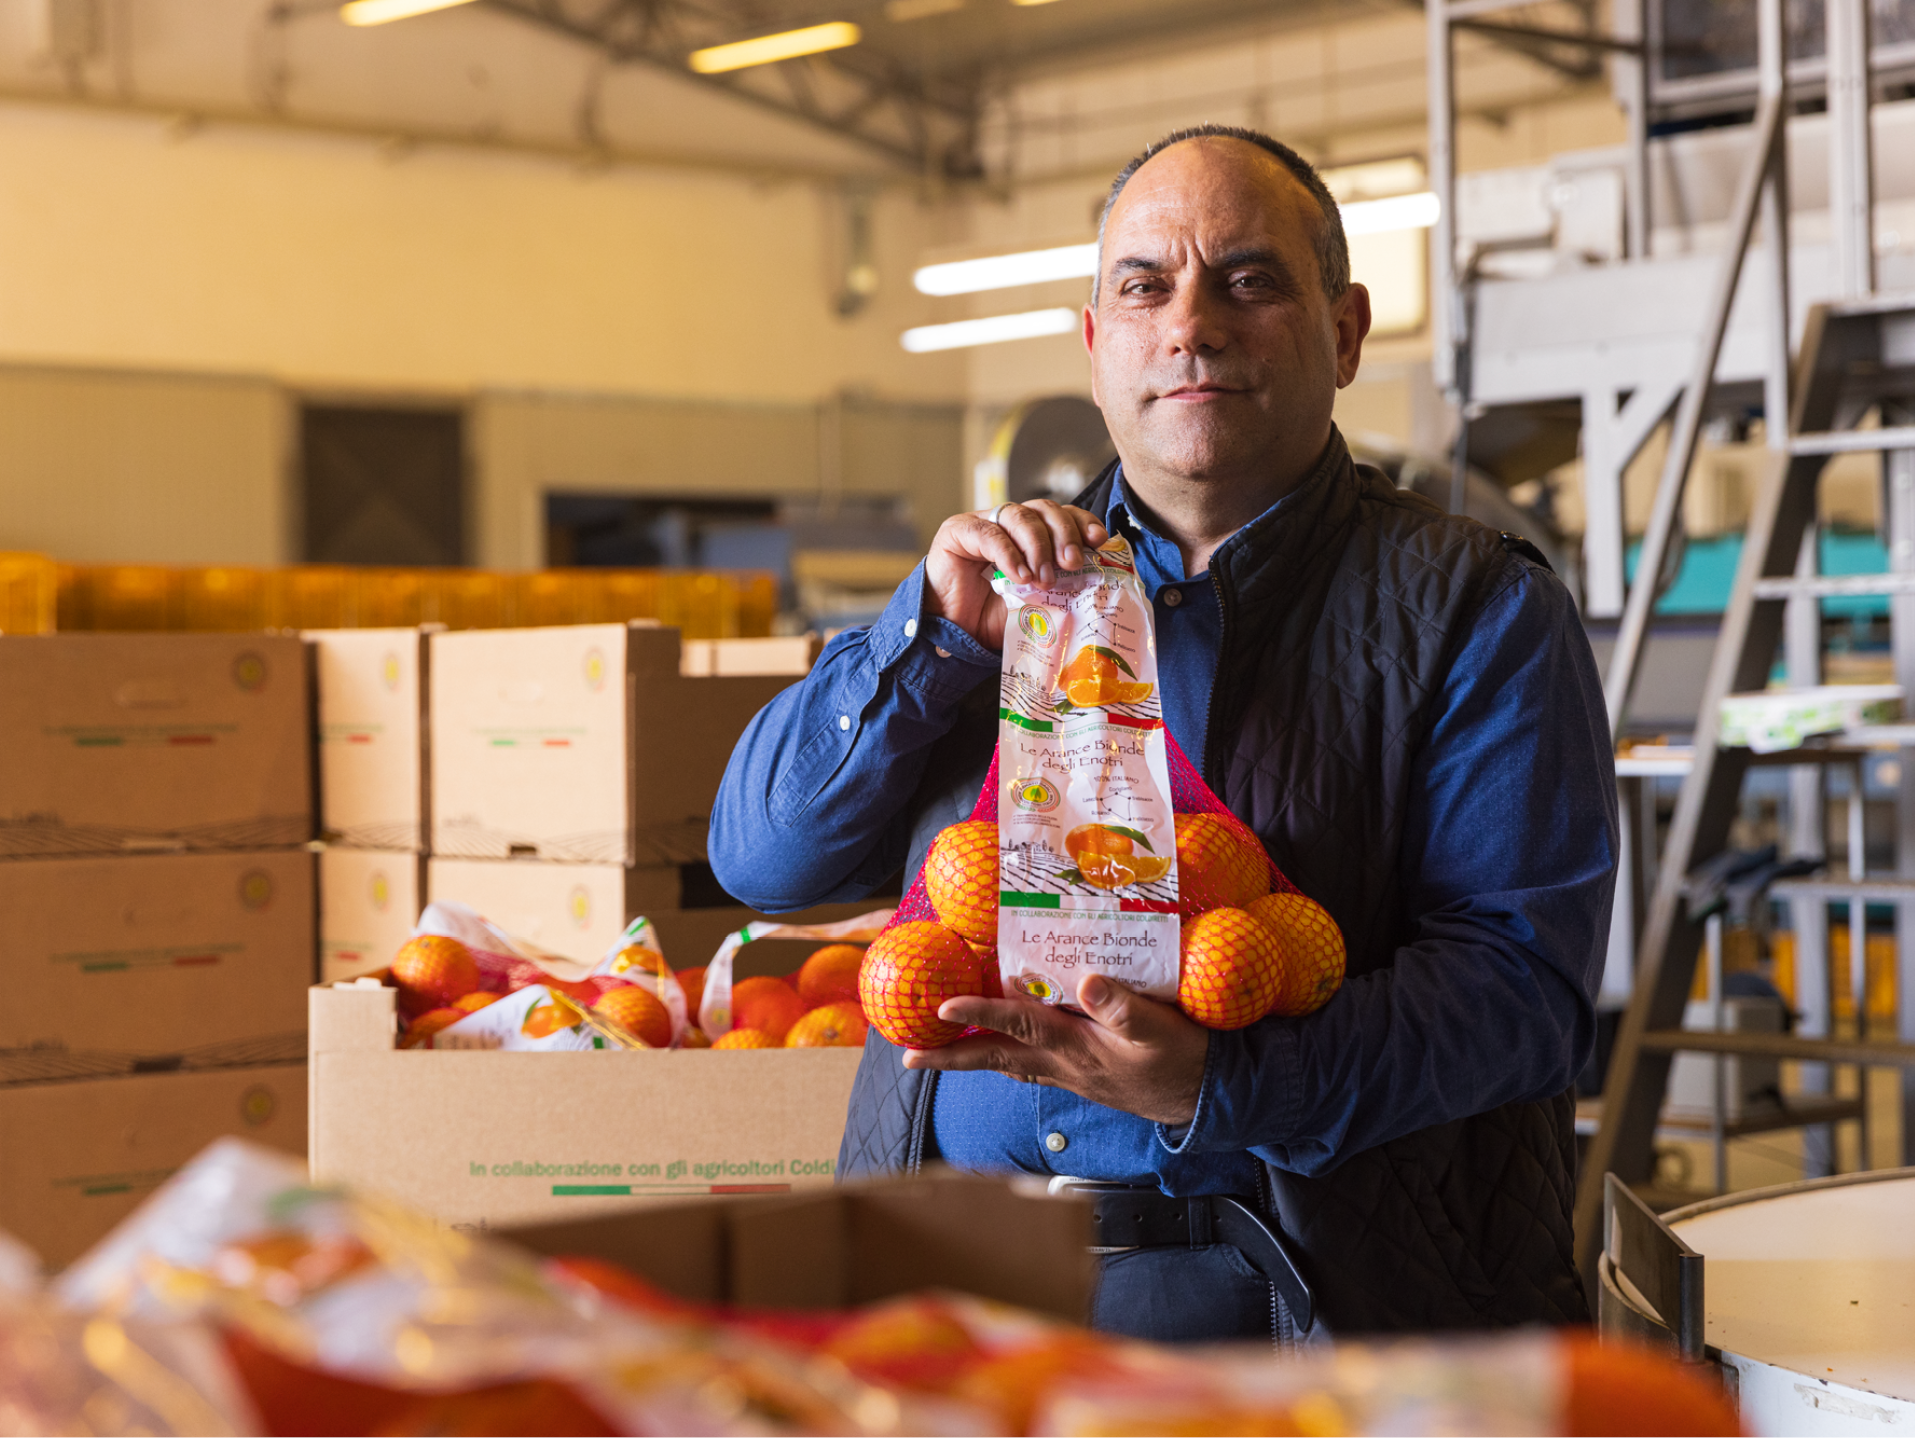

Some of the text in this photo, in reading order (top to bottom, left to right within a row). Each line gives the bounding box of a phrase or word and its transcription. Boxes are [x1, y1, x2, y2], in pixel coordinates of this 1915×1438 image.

[1065, 732, 1078, 740] CON
[1087, 723, 1122, 734] AGRICOLTORI
[1020, 739, 1145, 758] Le Arance Bionde
[1041, 756, 1123, 774] degli Enotri
[1111, 775, 1139, 785] ITALIANO
[1019, 910, 1071, 920] COLLABORAZIONE
[1073, 912, 1086, 920] CON
[1087, 912, 1096, 920] GLI
[1097, 912, 1135, 921] AGRICOLTORI
[1136, 914, 1169, 923] COLDIRETTI
[1022, 929, 1157, 947] Le Arance Bionde
[1045, 946, 1133, 969] degli Enotri
[1118, 977, 1147, 989] ITALIANO
[470, 1159, 836, 1181] In collaborazione con gli agricoltori Coldi
